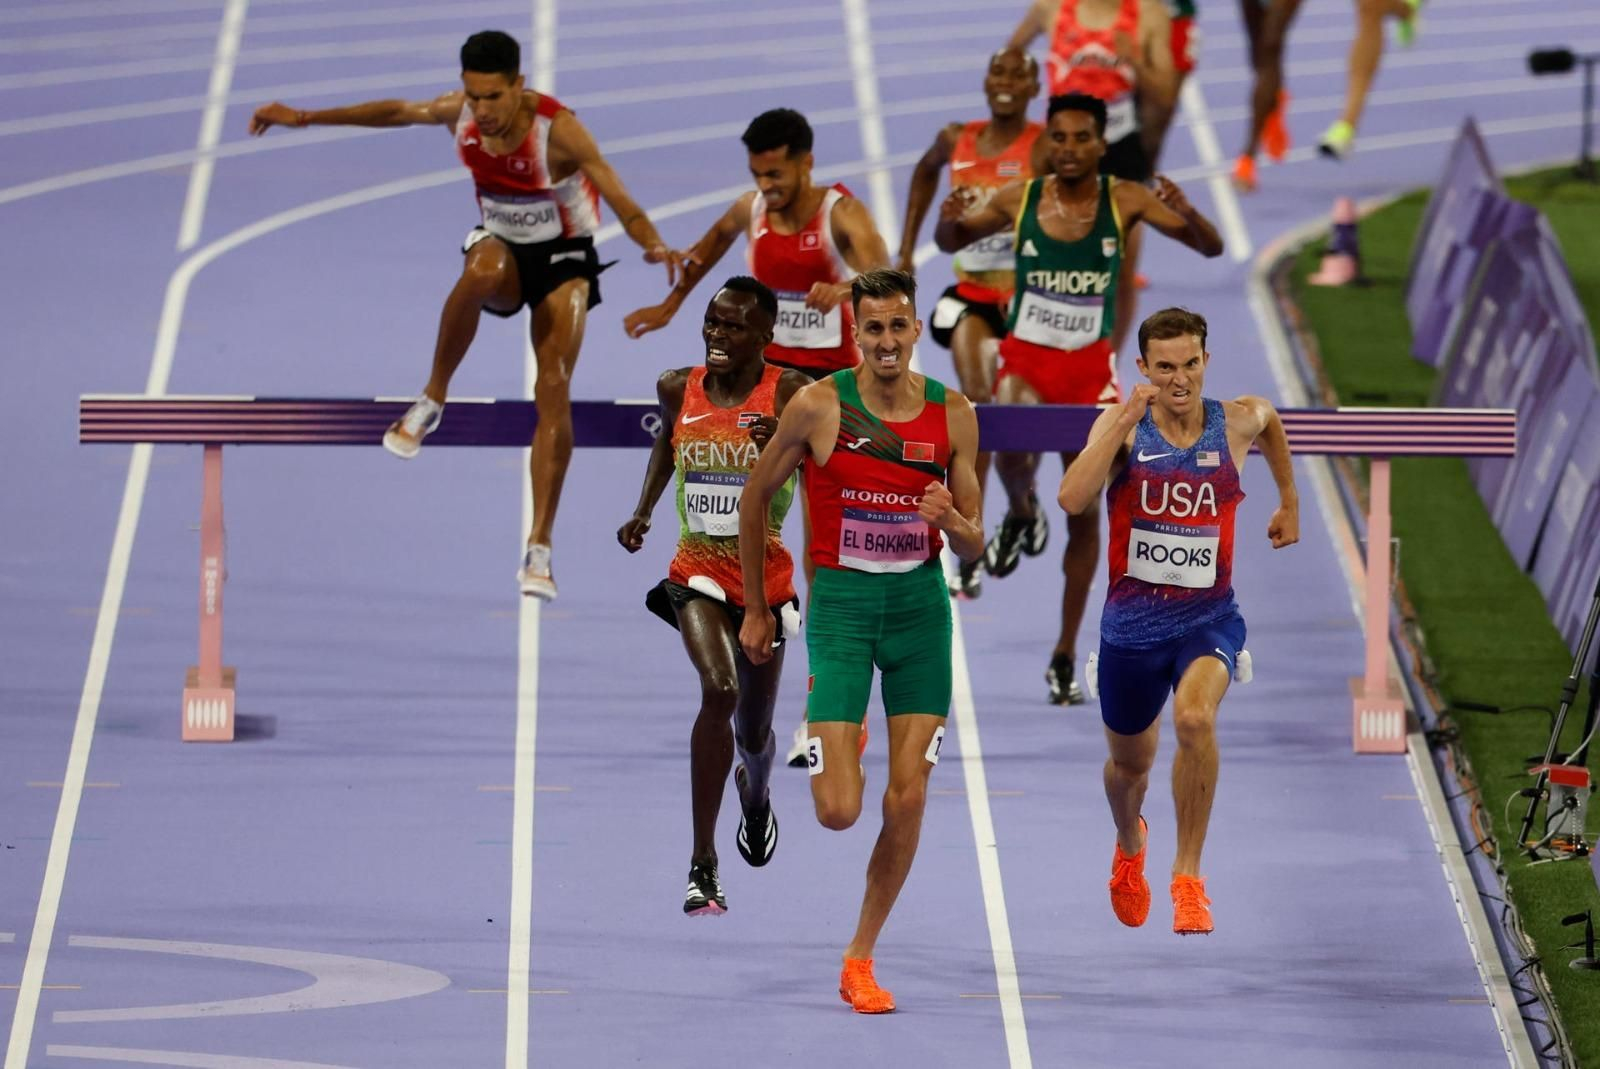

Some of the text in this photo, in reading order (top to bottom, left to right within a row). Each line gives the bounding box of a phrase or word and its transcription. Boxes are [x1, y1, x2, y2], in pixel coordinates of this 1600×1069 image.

[1026, 304, 1095, 333] FIREWU
[680, 441, 759, 468] KENYA
[701, 474, 722, 483] PARIS
[687, 493, 740, 515] KIBIW
[841, 487, 923, 507] MOROCC
[1141, 479, 1217, 518] USA
[867, 512, 891, 521] PARIS
[1155, 523, 1200, 535] PARIS 2024
[843, 529, 925, 553] EL BAKKALI
[1136, 540, 1211, 567] ROOKS
